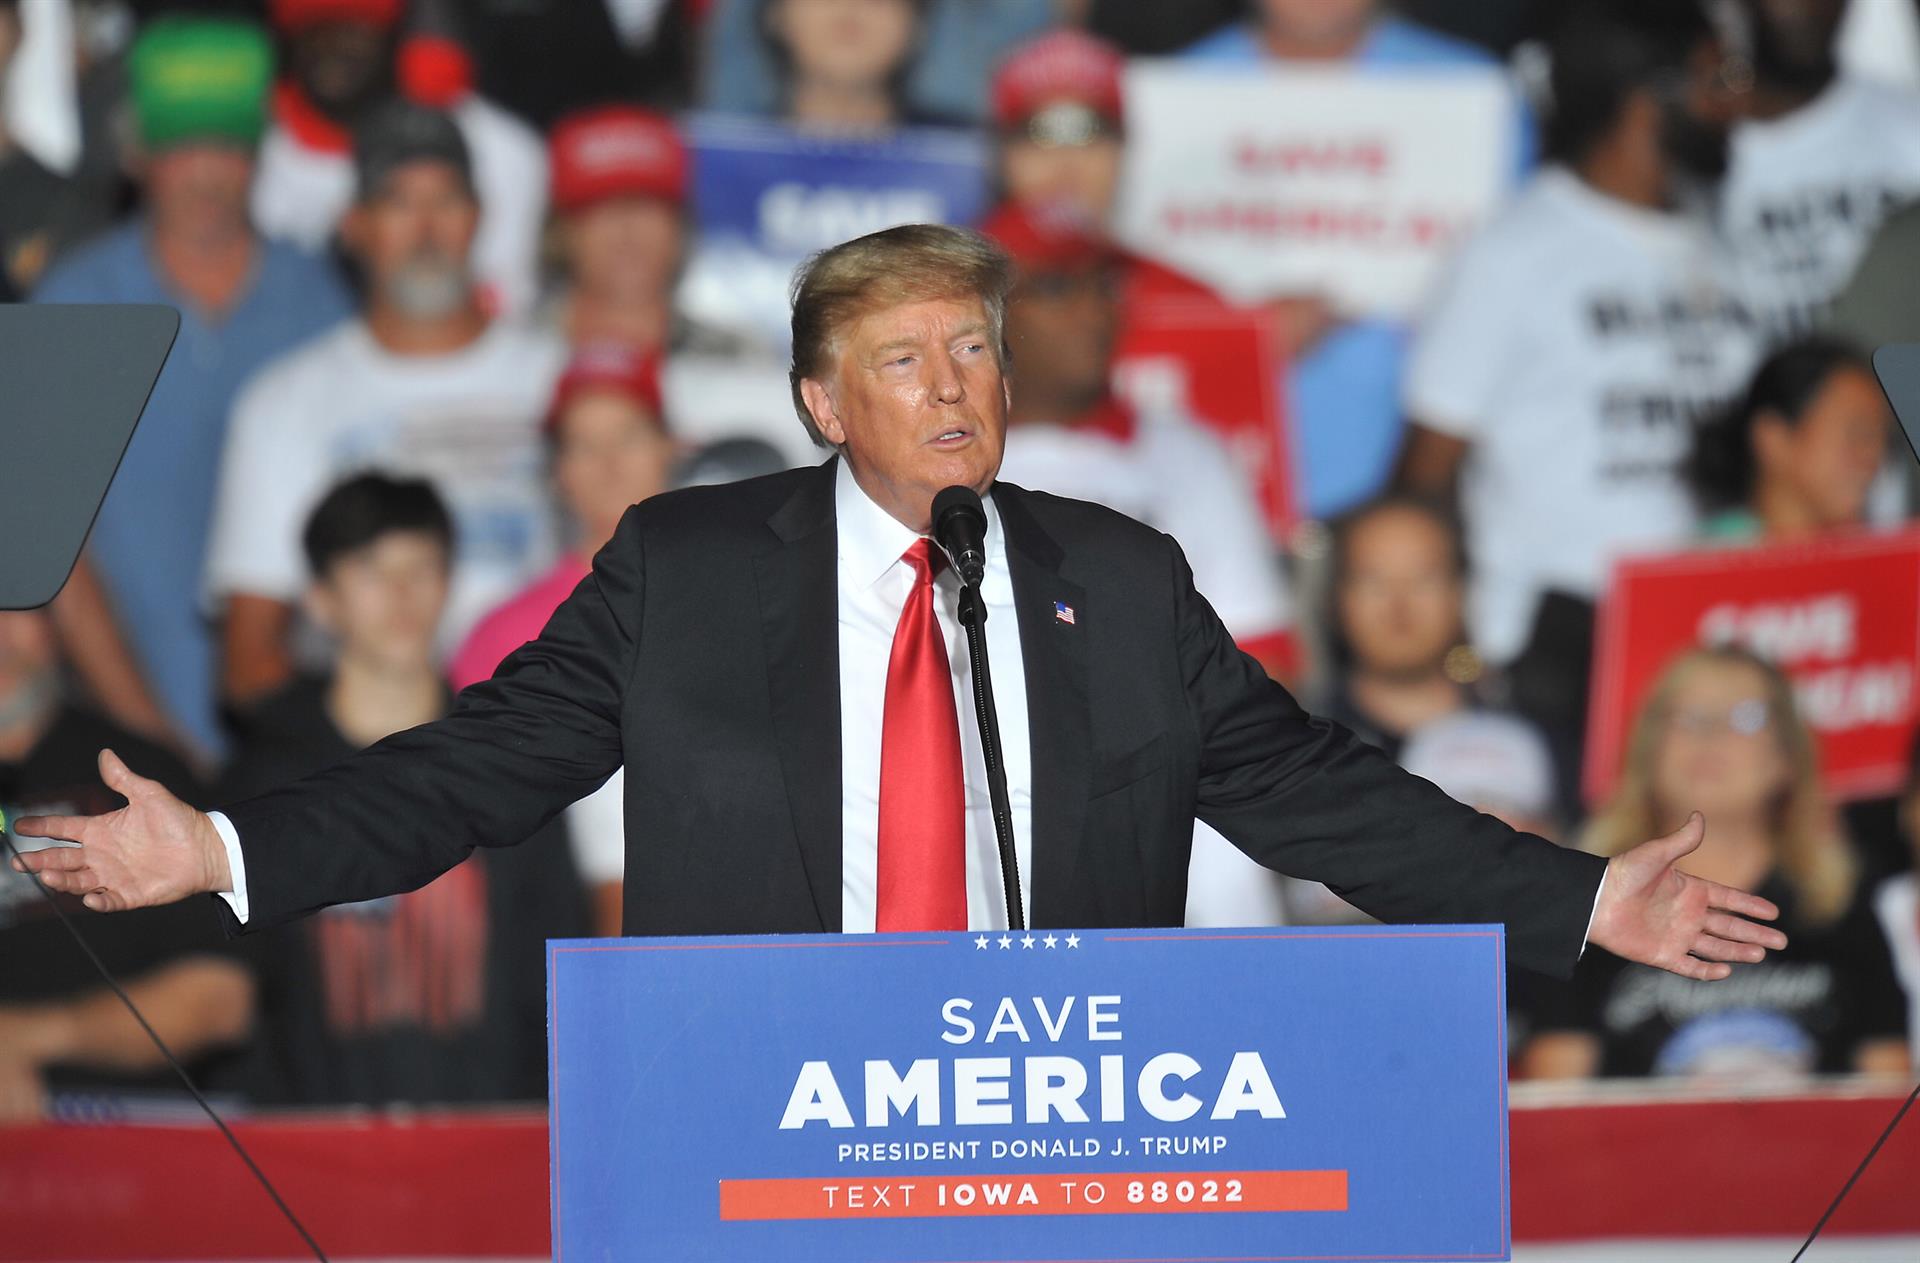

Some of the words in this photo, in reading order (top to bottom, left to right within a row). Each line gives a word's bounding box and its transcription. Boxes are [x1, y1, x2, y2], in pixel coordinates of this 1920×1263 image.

[942, 995, 1122, 1044] SAVE
[779, 1052, 1286, 1130] AMERICA
[838, 1140, 981, 1163] PRESIDENT
[991, 1138, 1101, 1159] DONALD
[1110, 1137, 1130, 1156] J.
[1140, 1135, 1228, 1156] TRUMP
[823, 1185, 915, 1208] TEXT
[938, 1182, 1039, 1207] IOWA
[1060, 1181, 1106, 1205] TO
[1126, 1178, 1243, 1204] 88022
